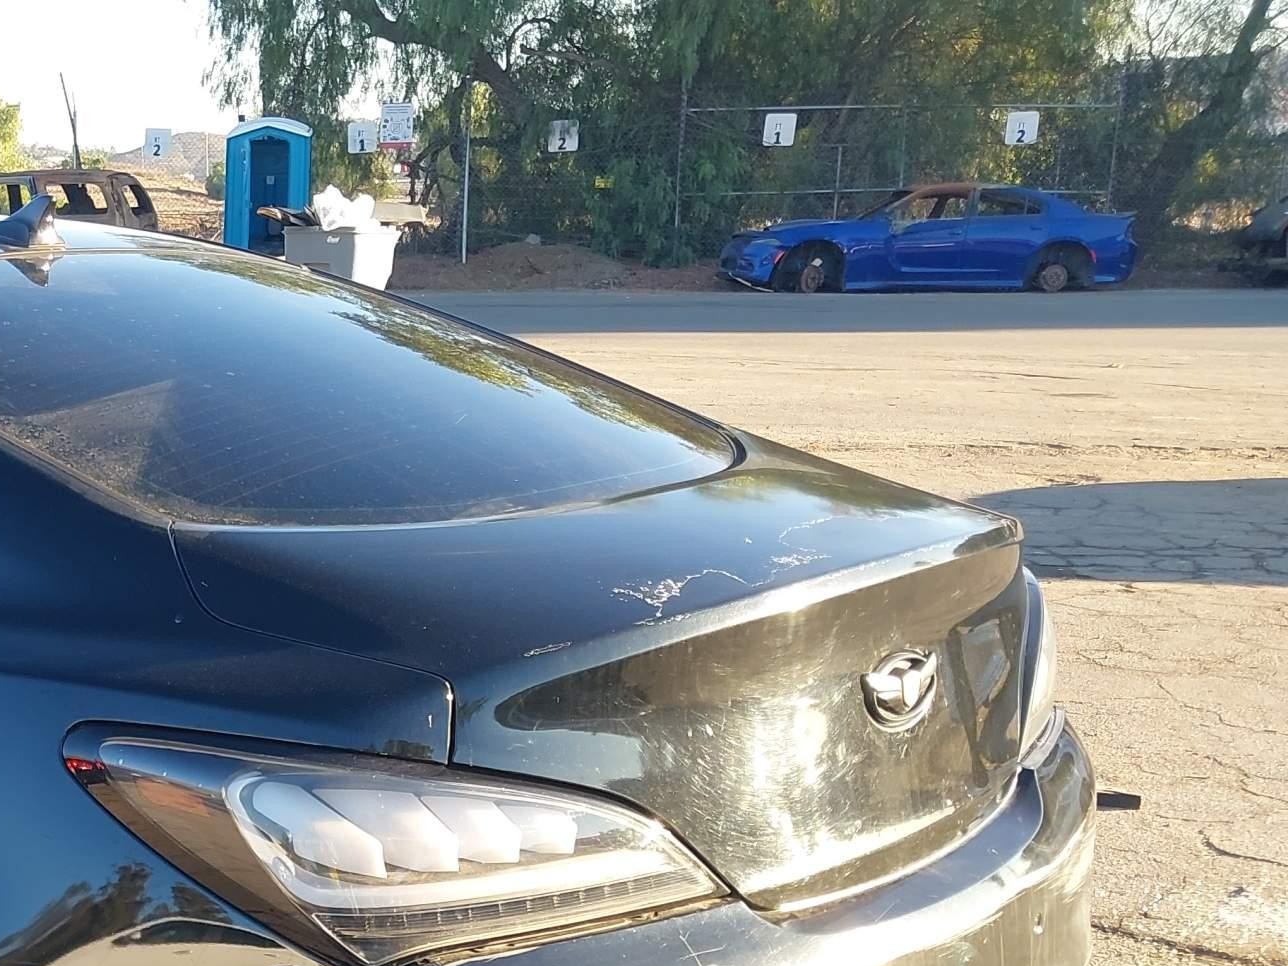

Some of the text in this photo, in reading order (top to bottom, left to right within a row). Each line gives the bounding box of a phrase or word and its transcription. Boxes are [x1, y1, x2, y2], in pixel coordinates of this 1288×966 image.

[774, 131, 782, 144] 1
[1016, 130, 1026, 143] 2
[153, 144, 161, 156] 2
[359, 139, 366, 151] 1
[558, 138, 567, 150] 2
